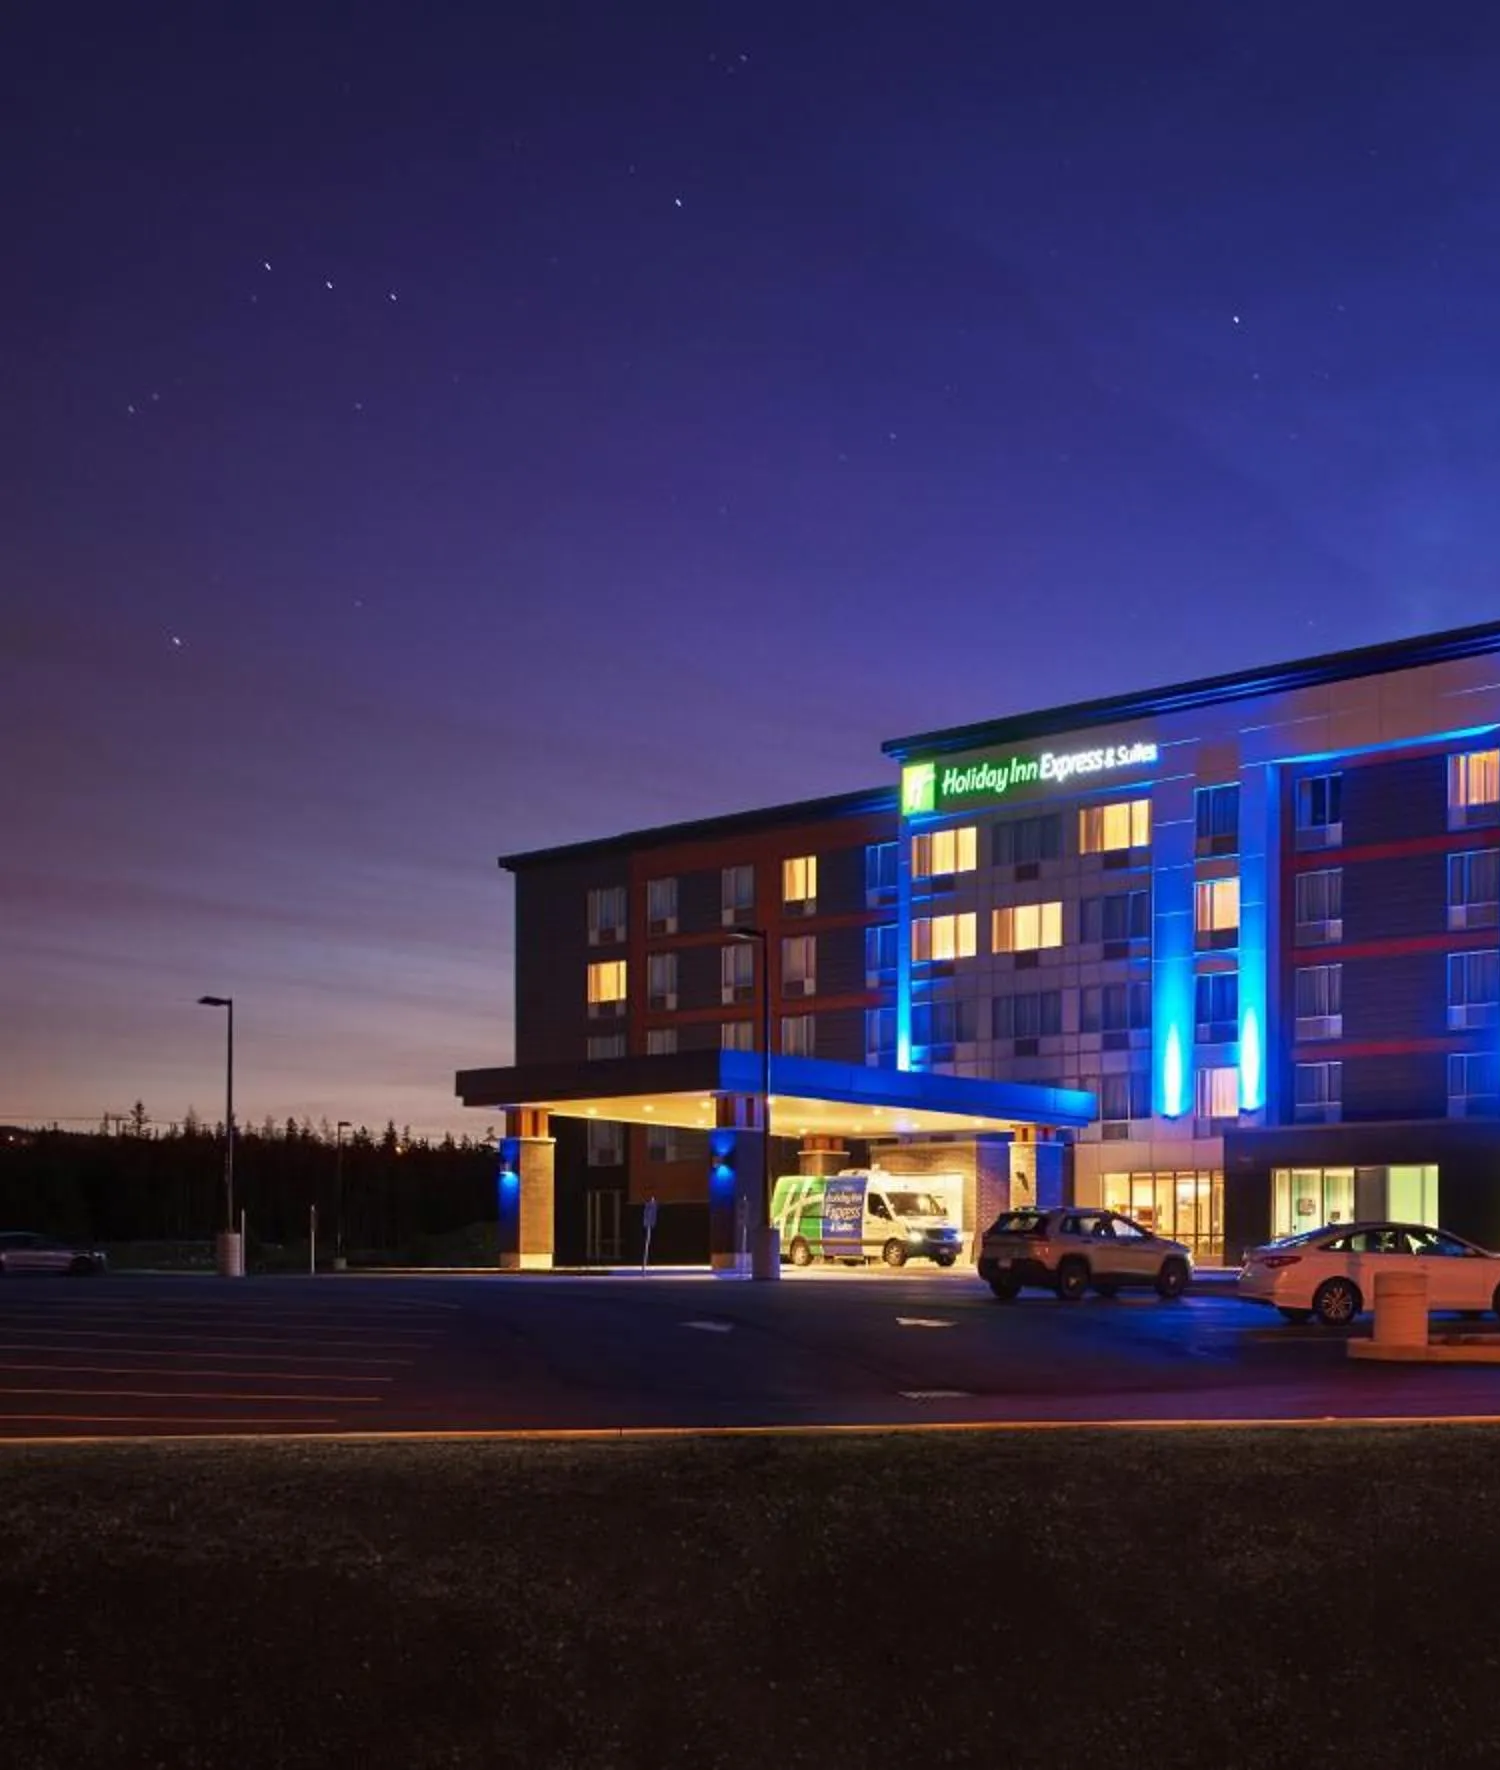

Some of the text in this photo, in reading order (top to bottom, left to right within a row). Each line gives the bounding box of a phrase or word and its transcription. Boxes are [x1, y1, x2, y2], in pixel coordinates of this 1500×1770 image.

[942, 741, 1159, 796] Holiday Inn Express & Suites
